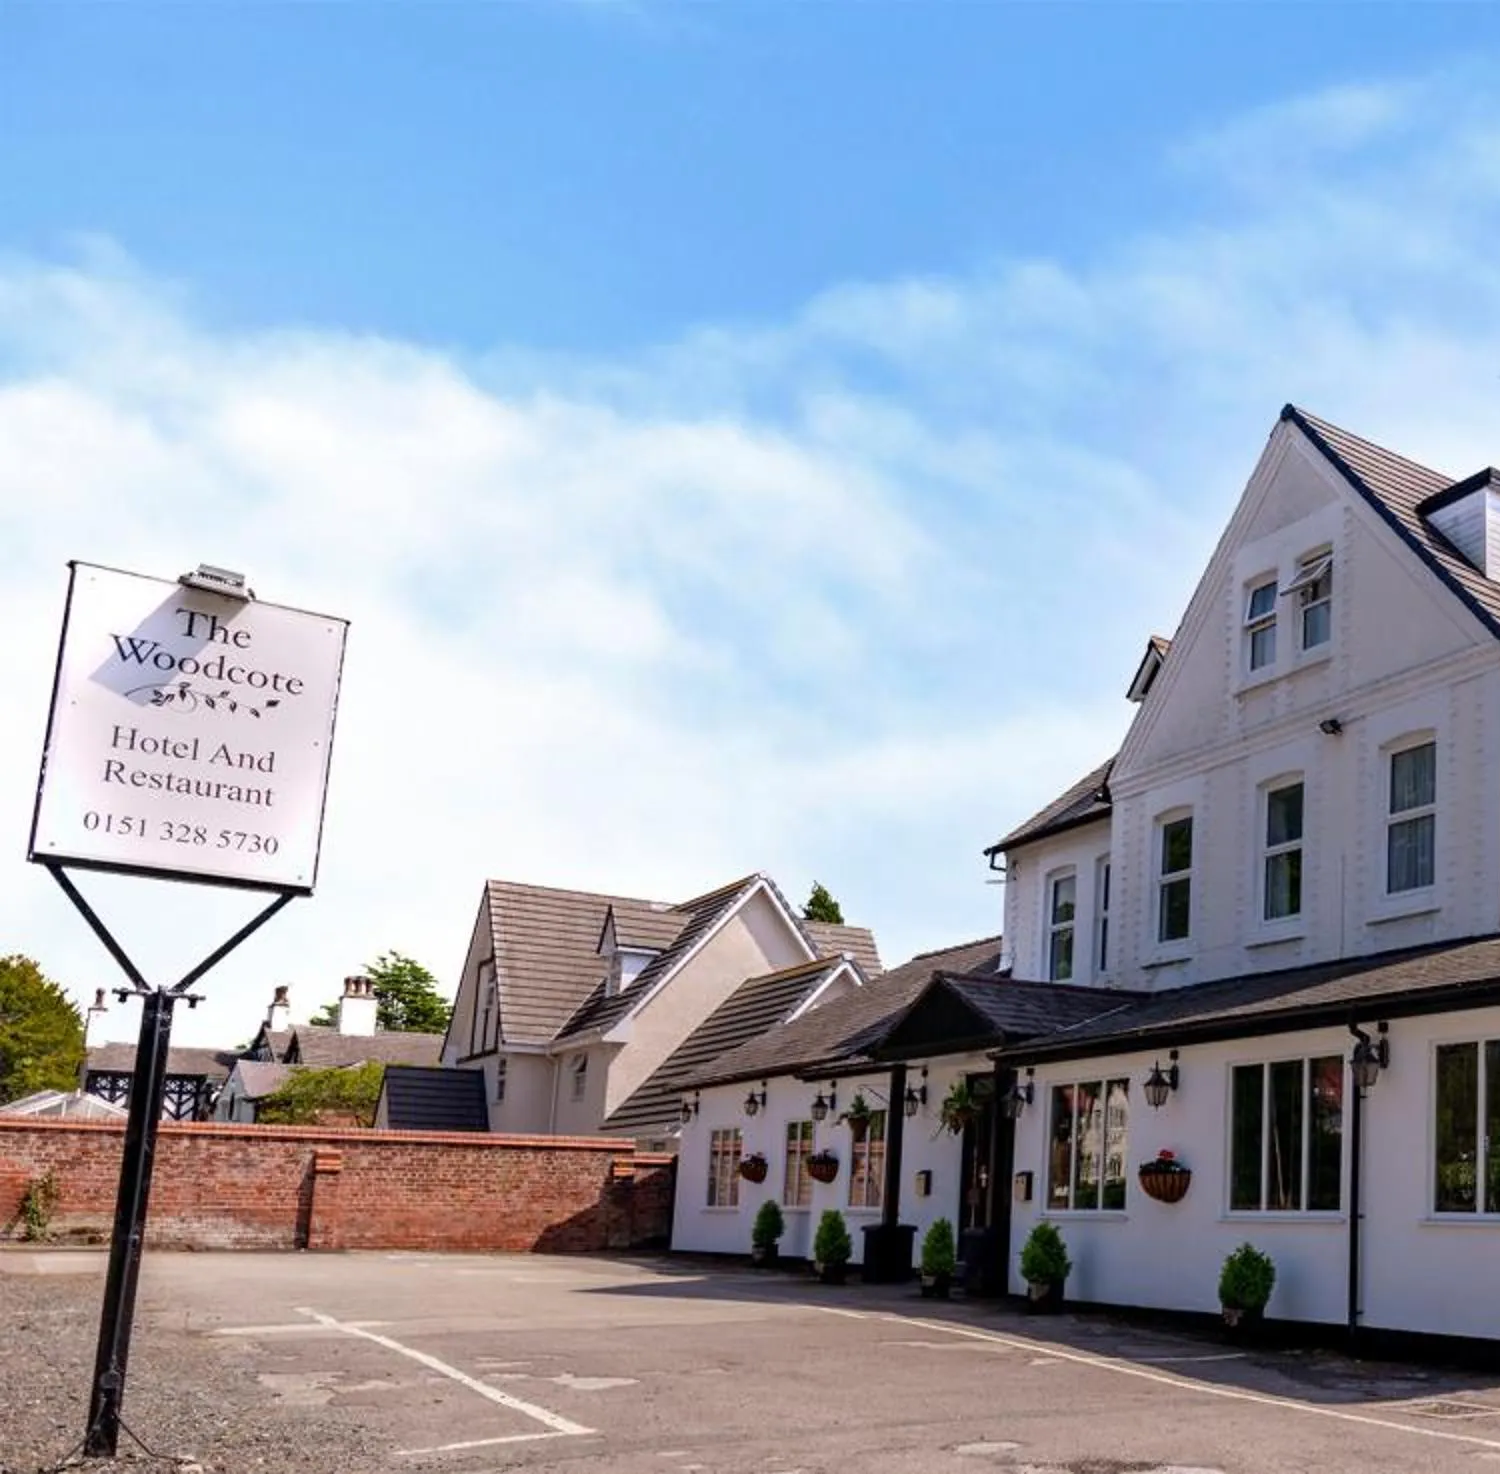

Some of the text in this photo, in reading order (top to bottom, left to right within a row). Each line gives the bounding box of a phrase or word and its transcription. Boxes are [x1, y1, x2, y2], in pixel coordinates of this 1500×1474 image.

[175, 607, 251, 649] The
[109, 633, 304, 695] Woodcote
[111, 724, 276, 773] Hotel And
[103, 759, 274, 807] Restaurant
[83, 810, 279, 856] 0151 328 5730
